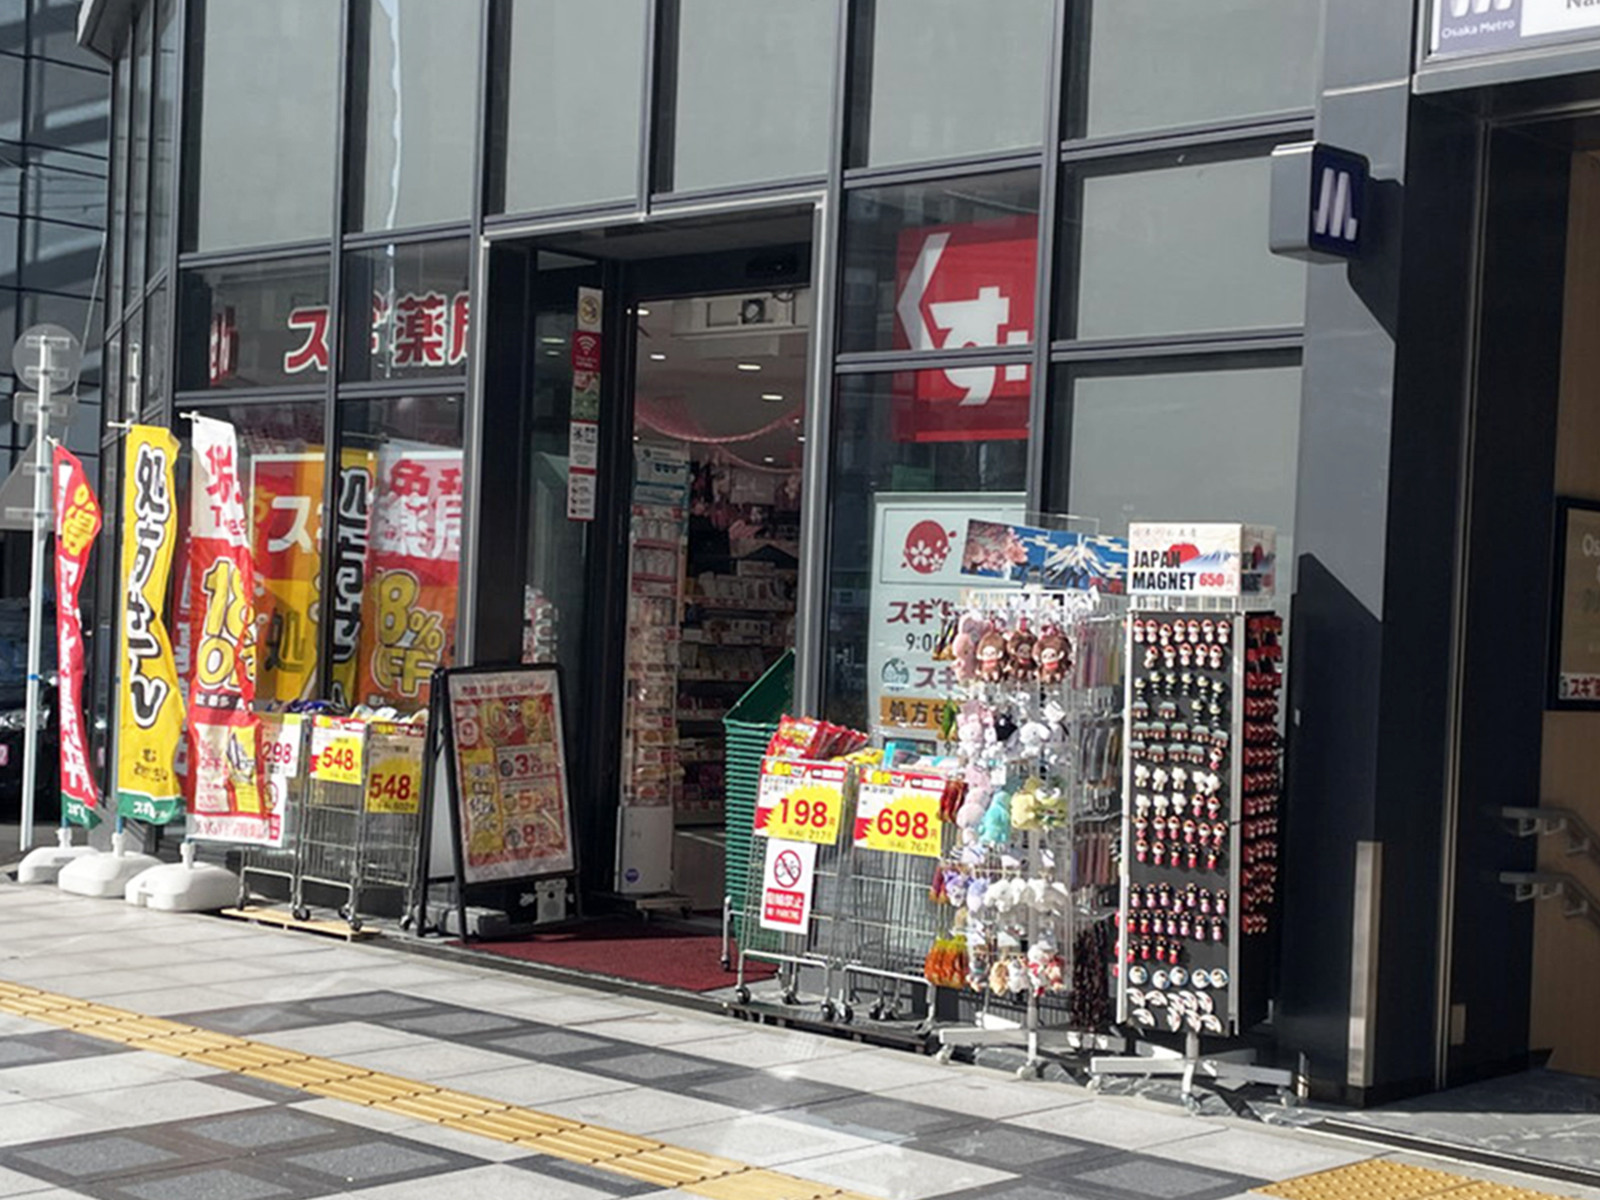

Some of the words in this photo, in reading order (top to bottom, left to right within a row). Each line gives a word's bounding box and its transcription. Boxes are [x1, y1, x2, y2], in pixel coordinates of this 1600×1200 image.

[1441, 25, 1478, 39] Osaka
[1479, 19, 1515, 34] Metro
[1133, 550, 1181, 568] JAPAN
[1132, 571, 1197, 591] MAGNET
[377, 568, 444, 648] 8%
[262, 740, 292, 764] 298
